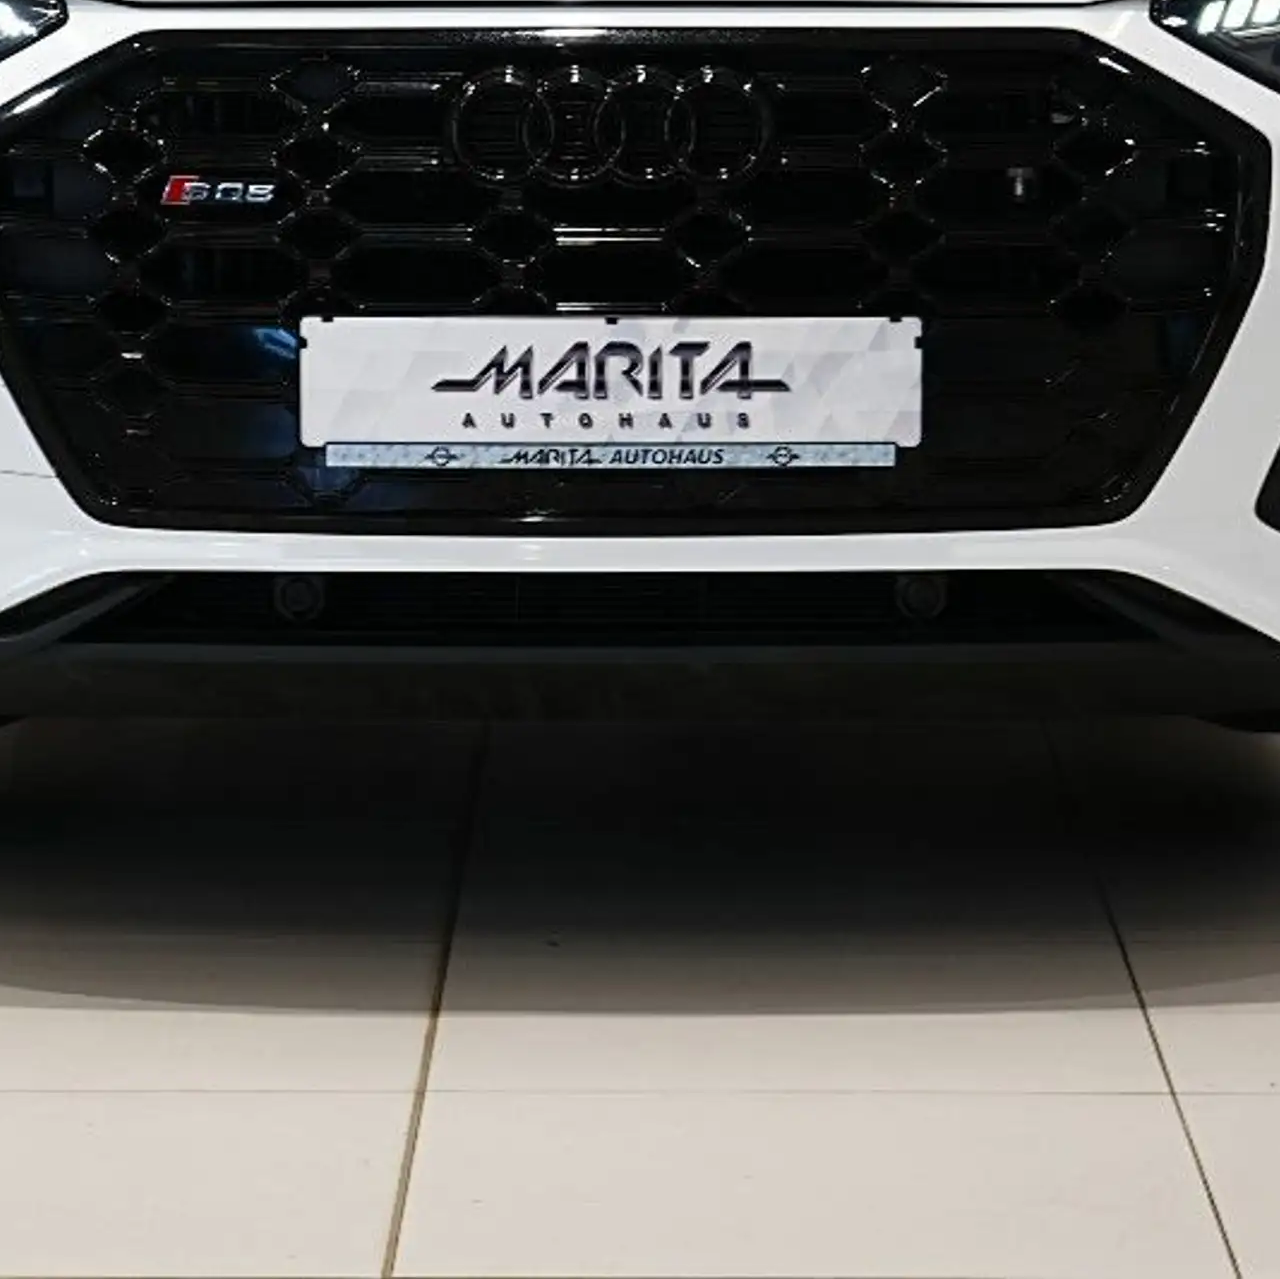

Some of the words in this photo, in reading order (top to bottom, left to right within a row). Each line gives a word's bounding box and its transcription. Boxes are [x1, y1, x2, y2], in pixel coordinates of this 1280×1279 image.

[176, 179, 276, 204] SQ5
[431, 340, 793, 401] MARITA
[461, 411, 752, 430] AUTOHAUS
[500, 449, 604, 466] MARITA
[608, 448, 725, 466] AUTOHAUS
